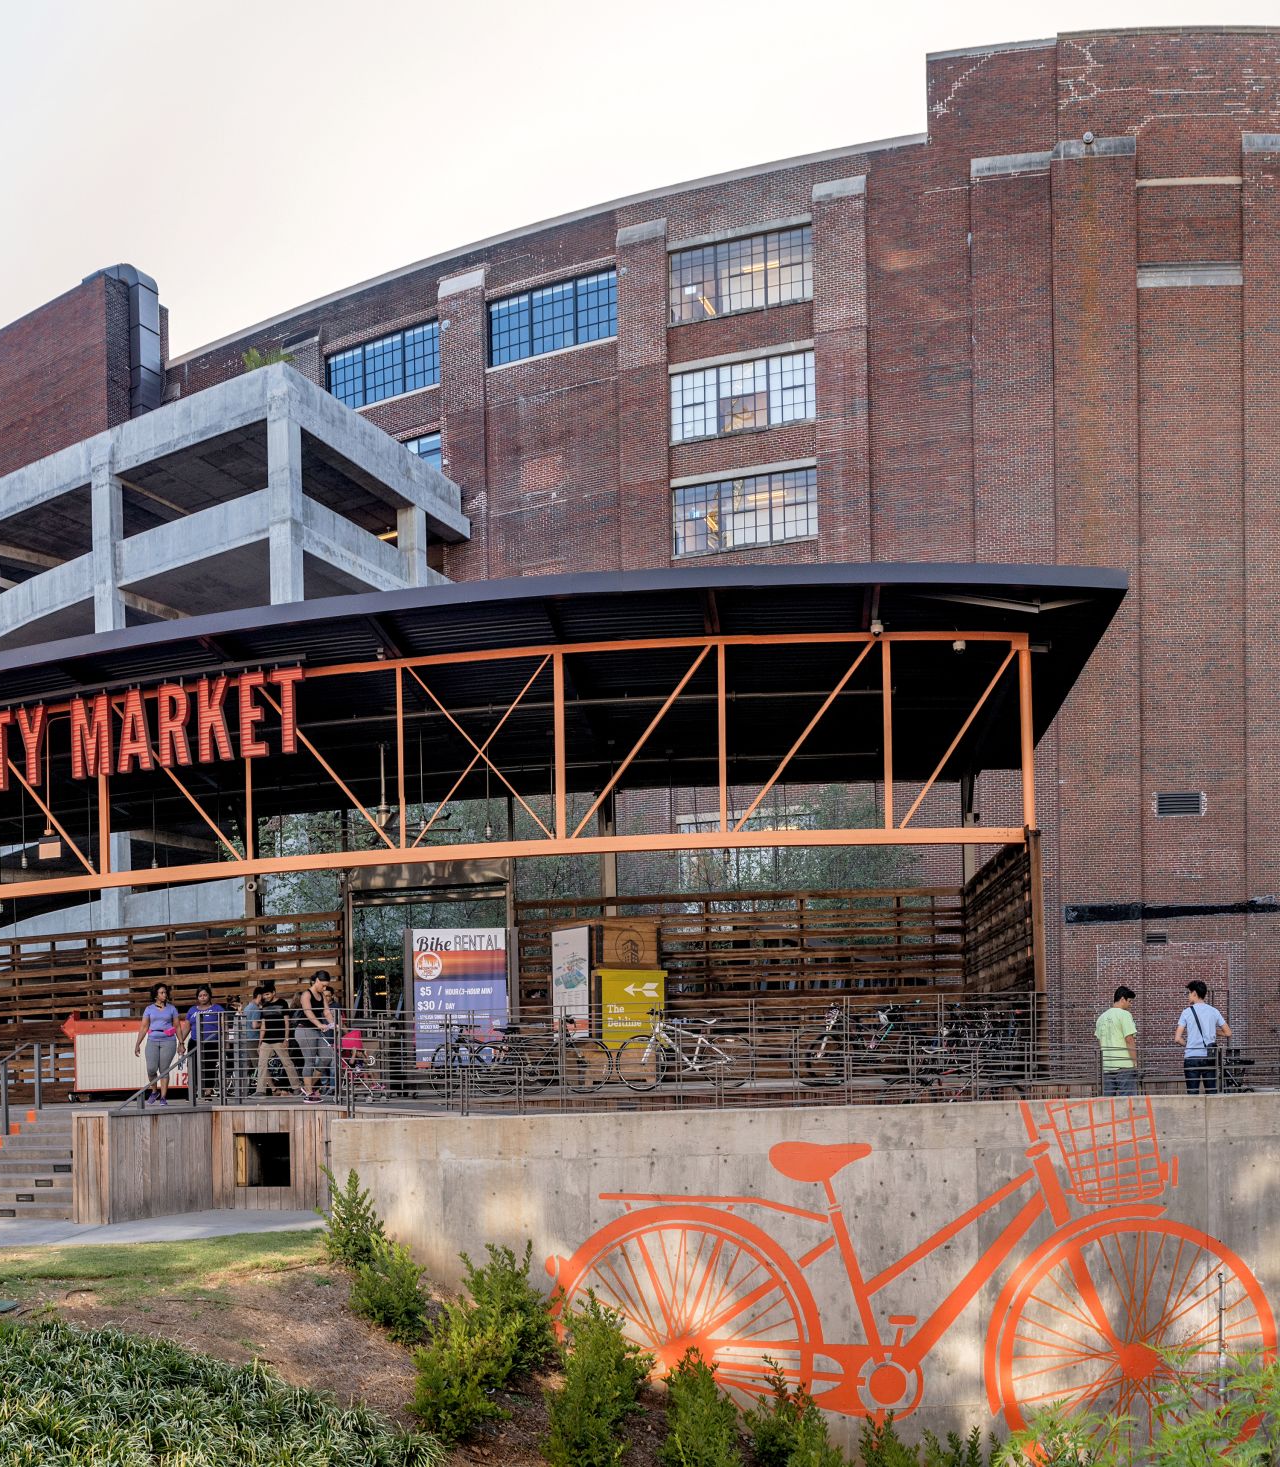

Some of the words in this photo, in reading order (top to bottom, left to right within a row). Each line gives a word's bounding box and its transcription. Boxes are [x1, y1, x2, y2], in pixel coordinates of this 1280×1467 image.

[70, 666, 305, 780] MARKET
[416, 936, 452, 952] Bike
[453, 934, 501, 951] RENTAL
[419, 986, 432, 997] $5
[445, 987, 459, 996] HOUR
[417, 1000, 435, 1011] $30
[445, 1002, 456, 1010] DAY
[607, 1004, 625, 1014] The
